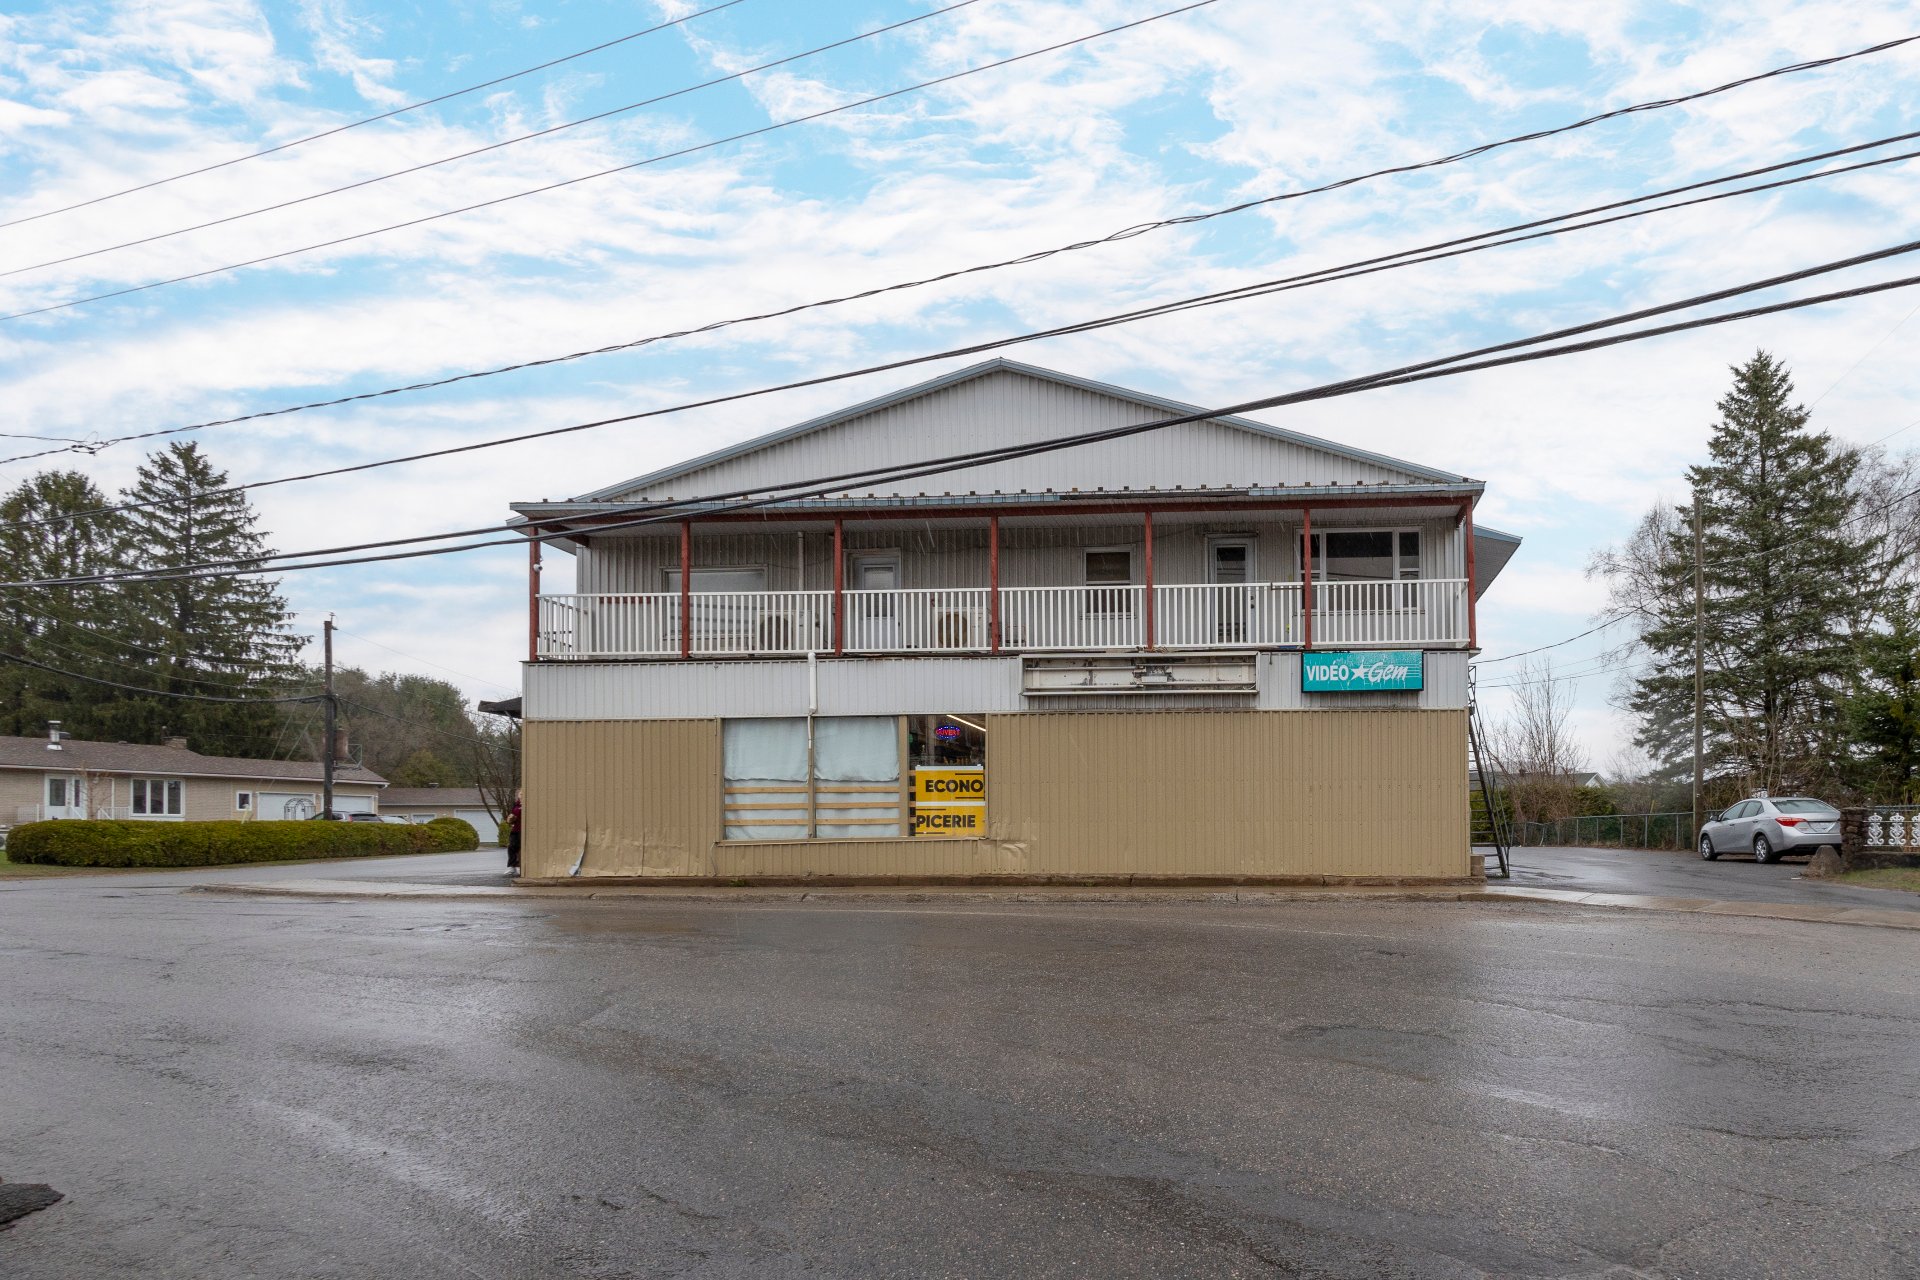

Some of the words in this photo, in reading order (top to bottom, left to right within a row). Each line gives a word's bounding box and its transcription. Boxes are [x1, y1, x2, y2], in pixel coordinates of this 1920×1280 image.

[1306, 660, 1349, 681] VIDÉO
[1368, 661, 1408, 683] Gem
[925, 779, 984, 793] ECONO
[916, 814, 976, 828] PICERIE
